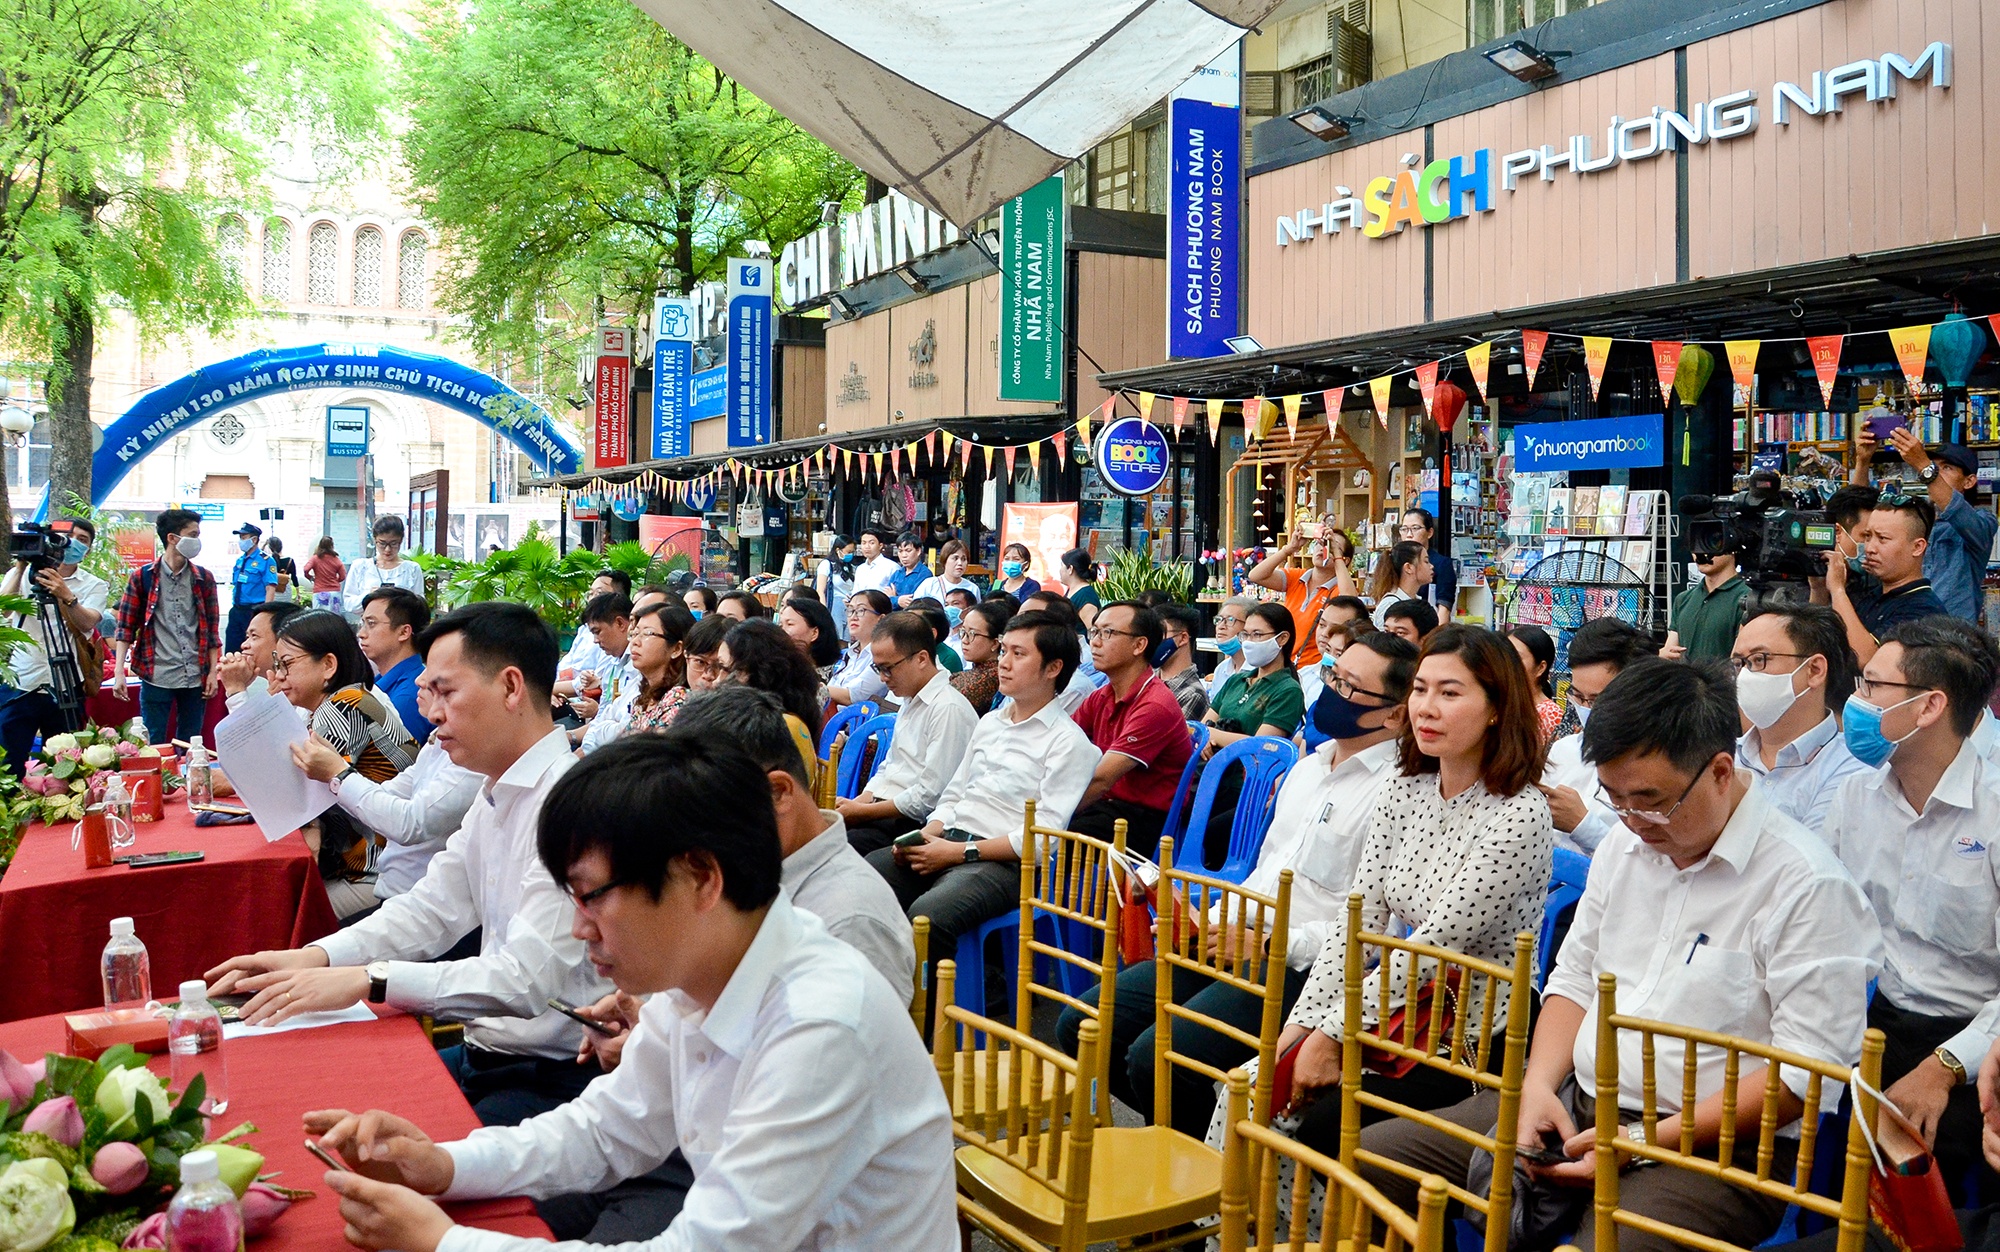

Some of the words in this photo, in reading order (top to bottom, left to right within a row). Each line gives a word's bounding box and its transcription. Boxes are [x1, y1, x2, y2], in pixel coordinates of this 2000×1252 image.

[1188, 128, 1205, 178] NAM
[1277, 185, 1362, 246] NHÀ
[1363, 148, 1496, 238] SÁCH
[1502, 89, 1759, 191] PHƯƠNG
[1772, 41, 1951, 126] NAM
[1211, 148, 1224, 196] BOOK
[1013, 197, 1023, 225] THÔNG
[1211, 201, 1223, 241] NAM
[1186, 182, 1204, 272] PHƯƠNG
[1013, 228, 1022, 259] TRUYỀN
[1046, 223, 1054, 285] Communications
[1027, 243, 1042, 290] NAM
[1210, 246, 1222, 318] PHUONG
[1013, 290, 1022, 307] VĂN
[1045, 288, 1053, 301] and
[1186, 275, 1203, 335] SÁCH
[1012, 311, 1022, 333] PHẦN
[1023, 296, 1041, 340] NHÃ
[1045, 303, 1054, 342] Publishing
[1012, 335, 1021, 346] CỔ
[1527, 341, 1537, 350] 130
[1900, 342, 1916, 354] 130
[660, 350, 675, 370] TRẺ
[1014, 348, 1021, 358] TY
[1589, 349, 1600, 358] 130
[1658, 354, 1671, 364] 130
[1733, 354, 1747, 365] 130
[1816, 350, 1831, 361] 130
[1012, 360, 1021, 384] CÔNG
[610, 387, 619, 400] CHÍ
[659, 373, 675, 396] BẢN
[141, 406, 190, 441] NIỆM
[190, 390, 225, 412] 130
[228, 371, 272, 397] NĂM
[277, 363, 329, 383] NGÀY
[334, 364, 380, 379] SINH
[385, 366, 422, 385] CHỦ
[426, 374, 465, 399] TỊCH
[524, 425, 567, 465] MINH
[658, 399, 674, 427] XUẤT
[599, 442, 608, 458] NHÀ
[610, 433, 618, 457] THÀNH
[659, 431, 674, 454] NHÀ
[1110, 444, 1161, 463] BOOK
[1534, 432, 1653, 462] phuongnambook
[1110, 461, 1161, 474] STORE
[1808, 531, 1831, 541] VTC
